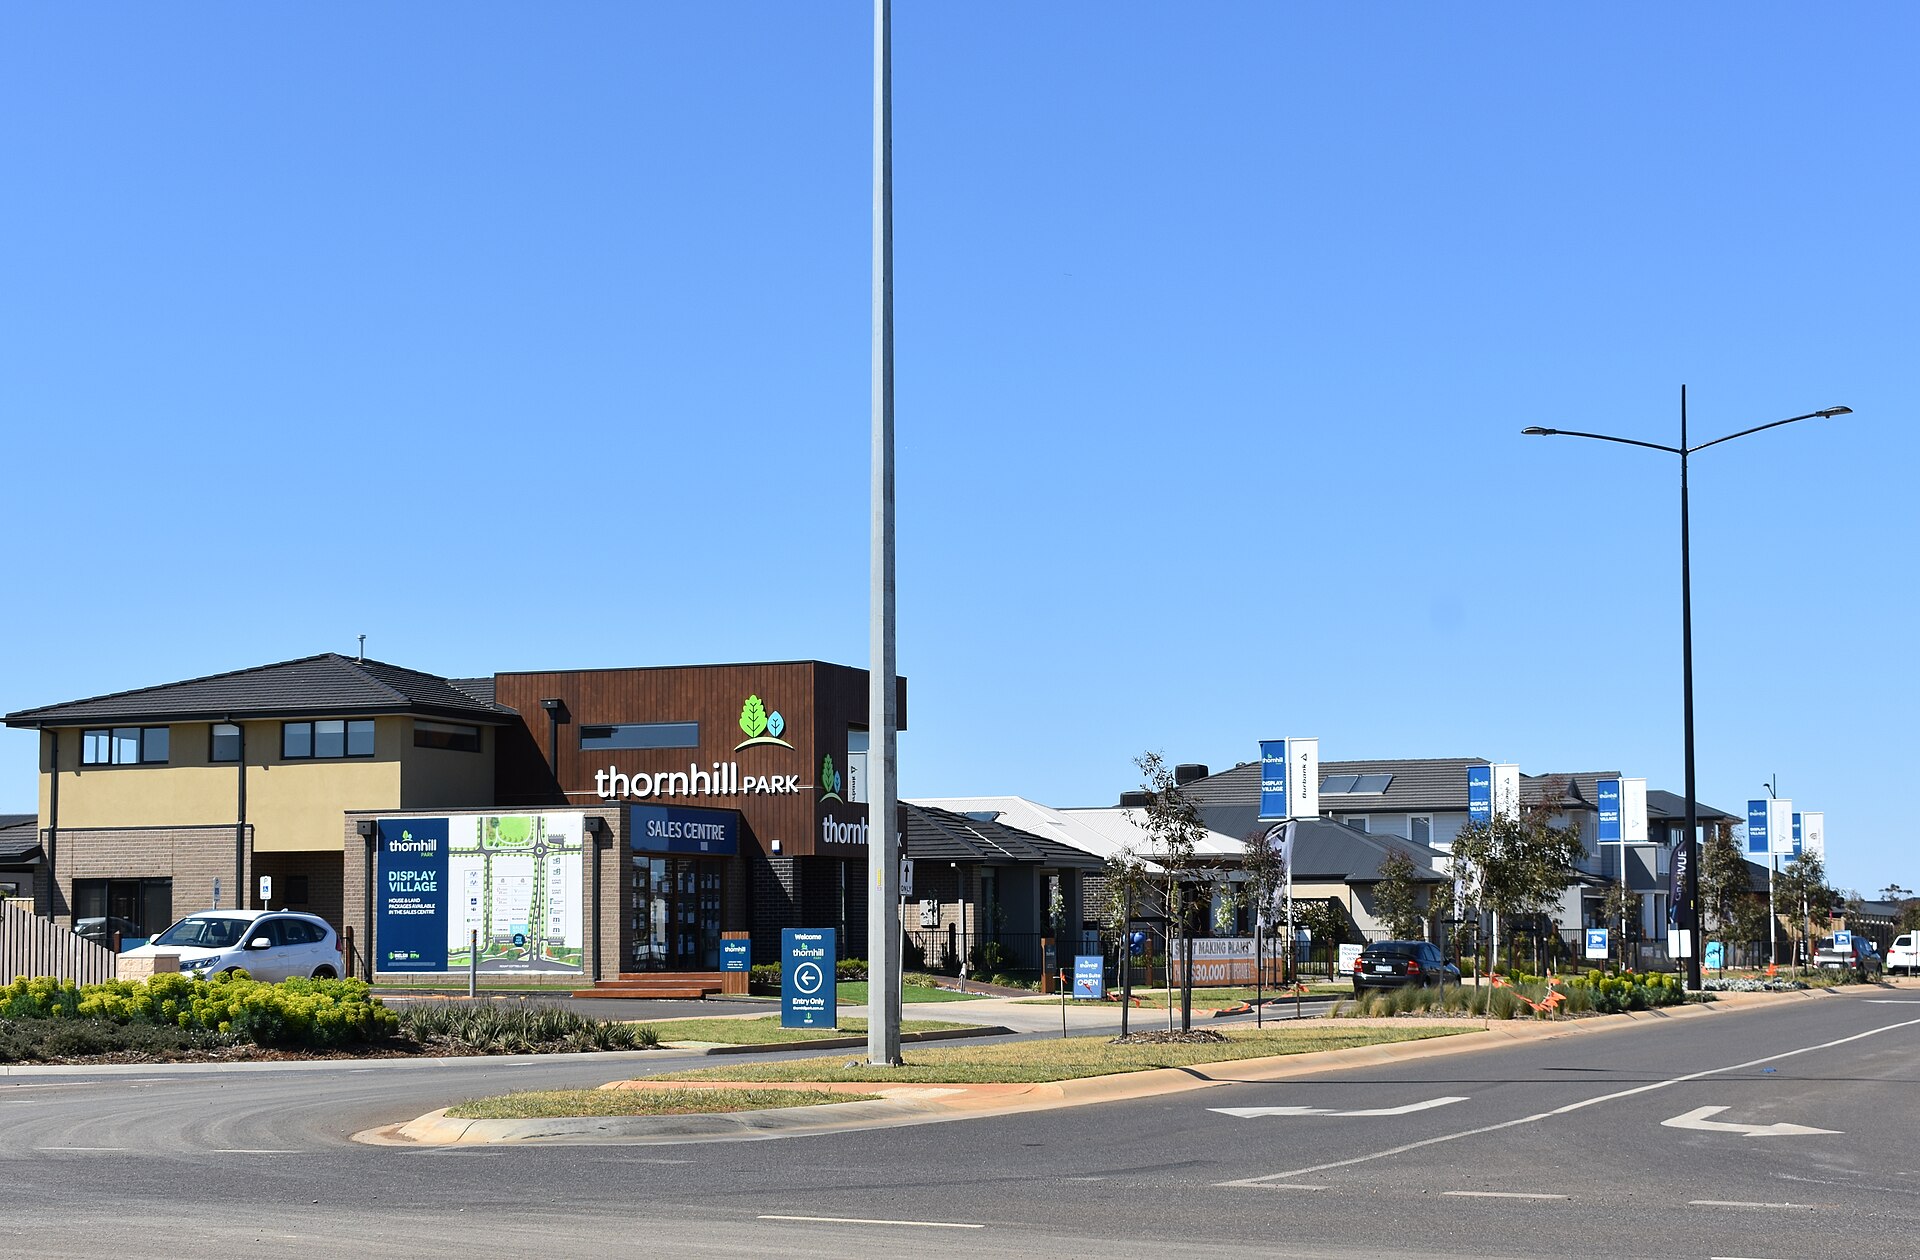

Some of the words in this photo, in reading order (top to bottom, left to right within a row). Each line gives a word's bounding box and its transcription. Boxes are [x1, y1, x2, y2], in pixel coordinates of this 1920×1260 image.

[595, 761, 738, 798] thornhill
[743, 774, 800, 794] PARK
[647, 820, 682, 837] SALES
[683, 823, 725, 841] CENTRE
[822, 814, 869, 844] thornh
[389, 838, 437, 852] thornhill
[388, 870, 436, 882] DISPLAY
[388, 882, 437, 892] VILLAGE
[792, 948, 824, 956] thornhill
[1199, 940, 1226, 954] MAKING
[792, 998, 809, 1006] Entry
[810, 998, 825, 1006] Only
